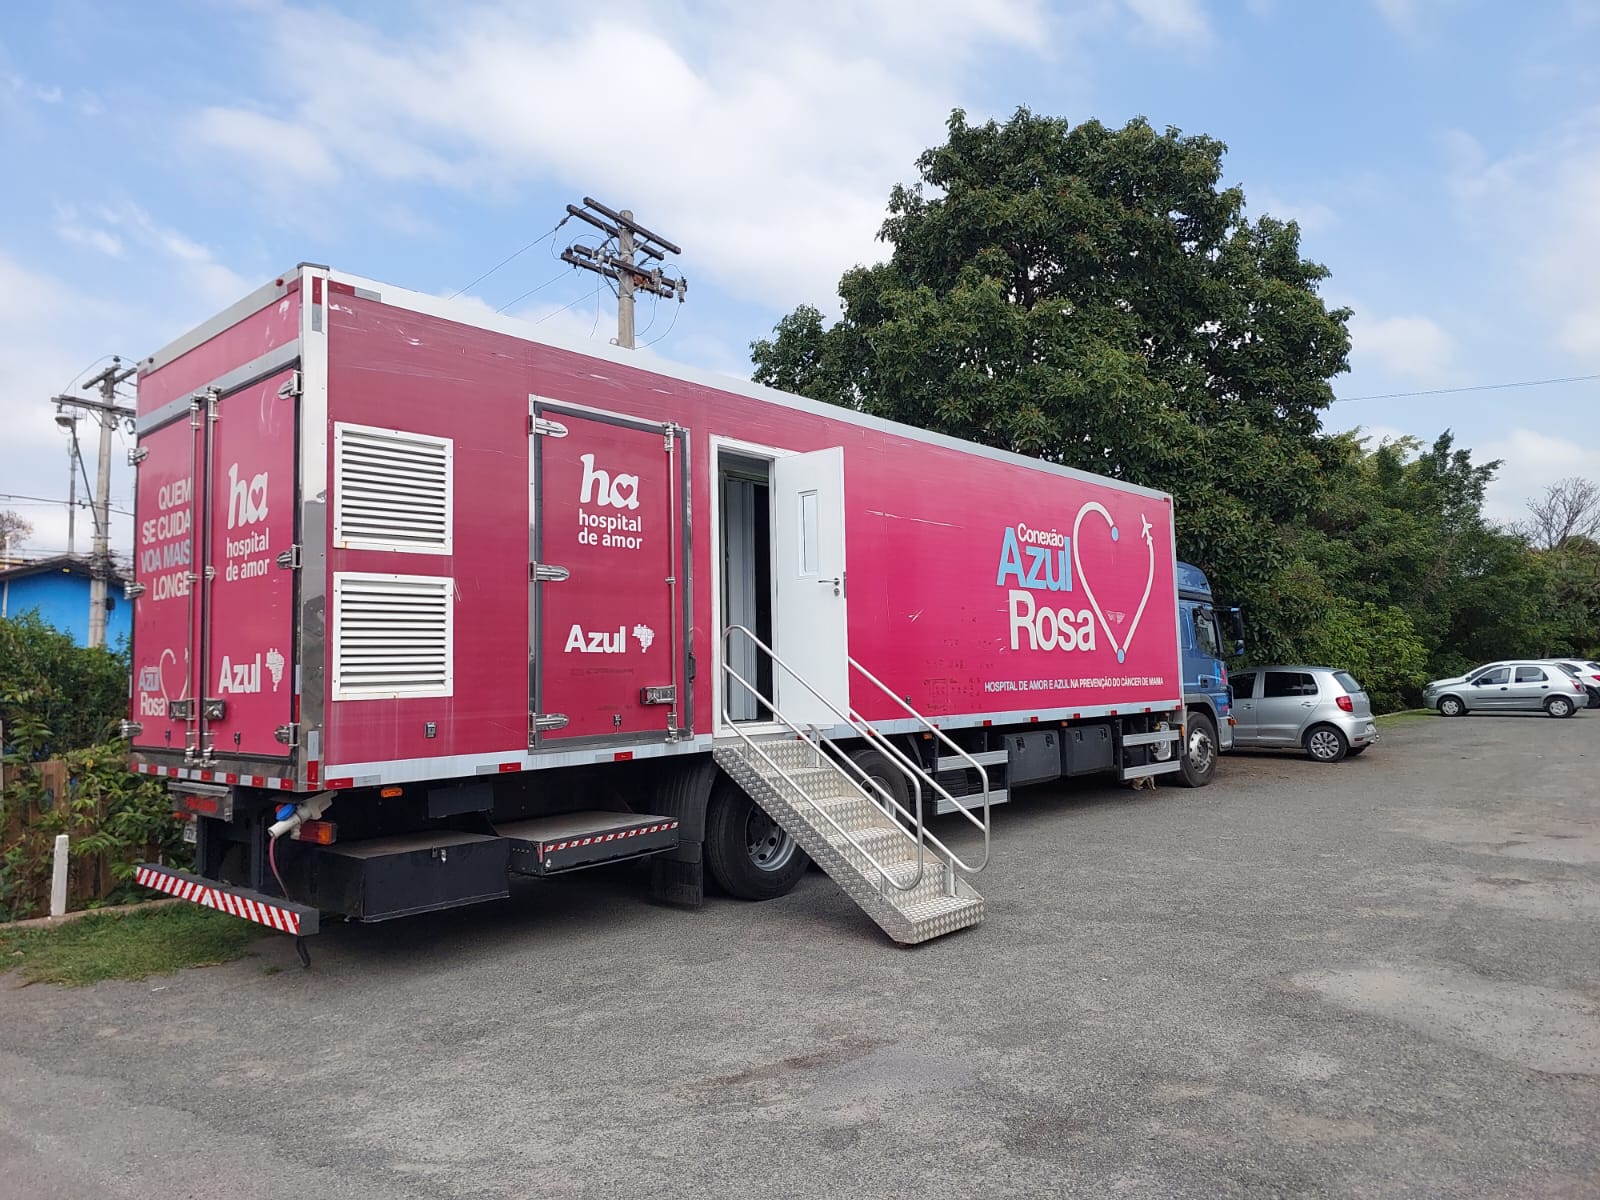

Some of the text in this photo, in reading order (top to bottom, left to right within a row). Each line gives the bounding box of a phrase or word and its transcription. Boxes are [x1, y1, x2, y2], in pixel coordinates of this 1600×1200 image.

[158, 477, 192, 510] QUEM
[142, 509, 191, 545] SE CUIDA
[578, 508, 642, 533] hospital
[1017, 522, 1064, 547] Conexão
[226, 527, 269, 560] hospital
[578, 527, 643, 550] de amor
[140, 538, 191, 574] VOA MAIS
[226, 558, 271, 582] de amor
[996, 526, 1073, 592] Azul
[152, 570, 191, 601] LONGE
[1008, 589, 1097, 652] Rosa
[563, 624, 627, 654] Azul
[217, 652, 261, 694] Azul
[984, 680, 1018, 693] HOSPITAL
[1018, 680, 1029, 691] DE
[1029, 679, 1049, 691] AMOR
[1048, 679, 1054, 690] E
[1053, 678, 1070, 689] AZUL
[1070, 678, 1080, 689] NA
[1079, 676, 1113, 690] PREVENÇÃO
[1112, 677, 1121, 688] DO
[1120, 675, 1141, 687] CÂNCER
[1141, 677, 1149, 687] DE
[140, 691, 166, 717] Rosa
